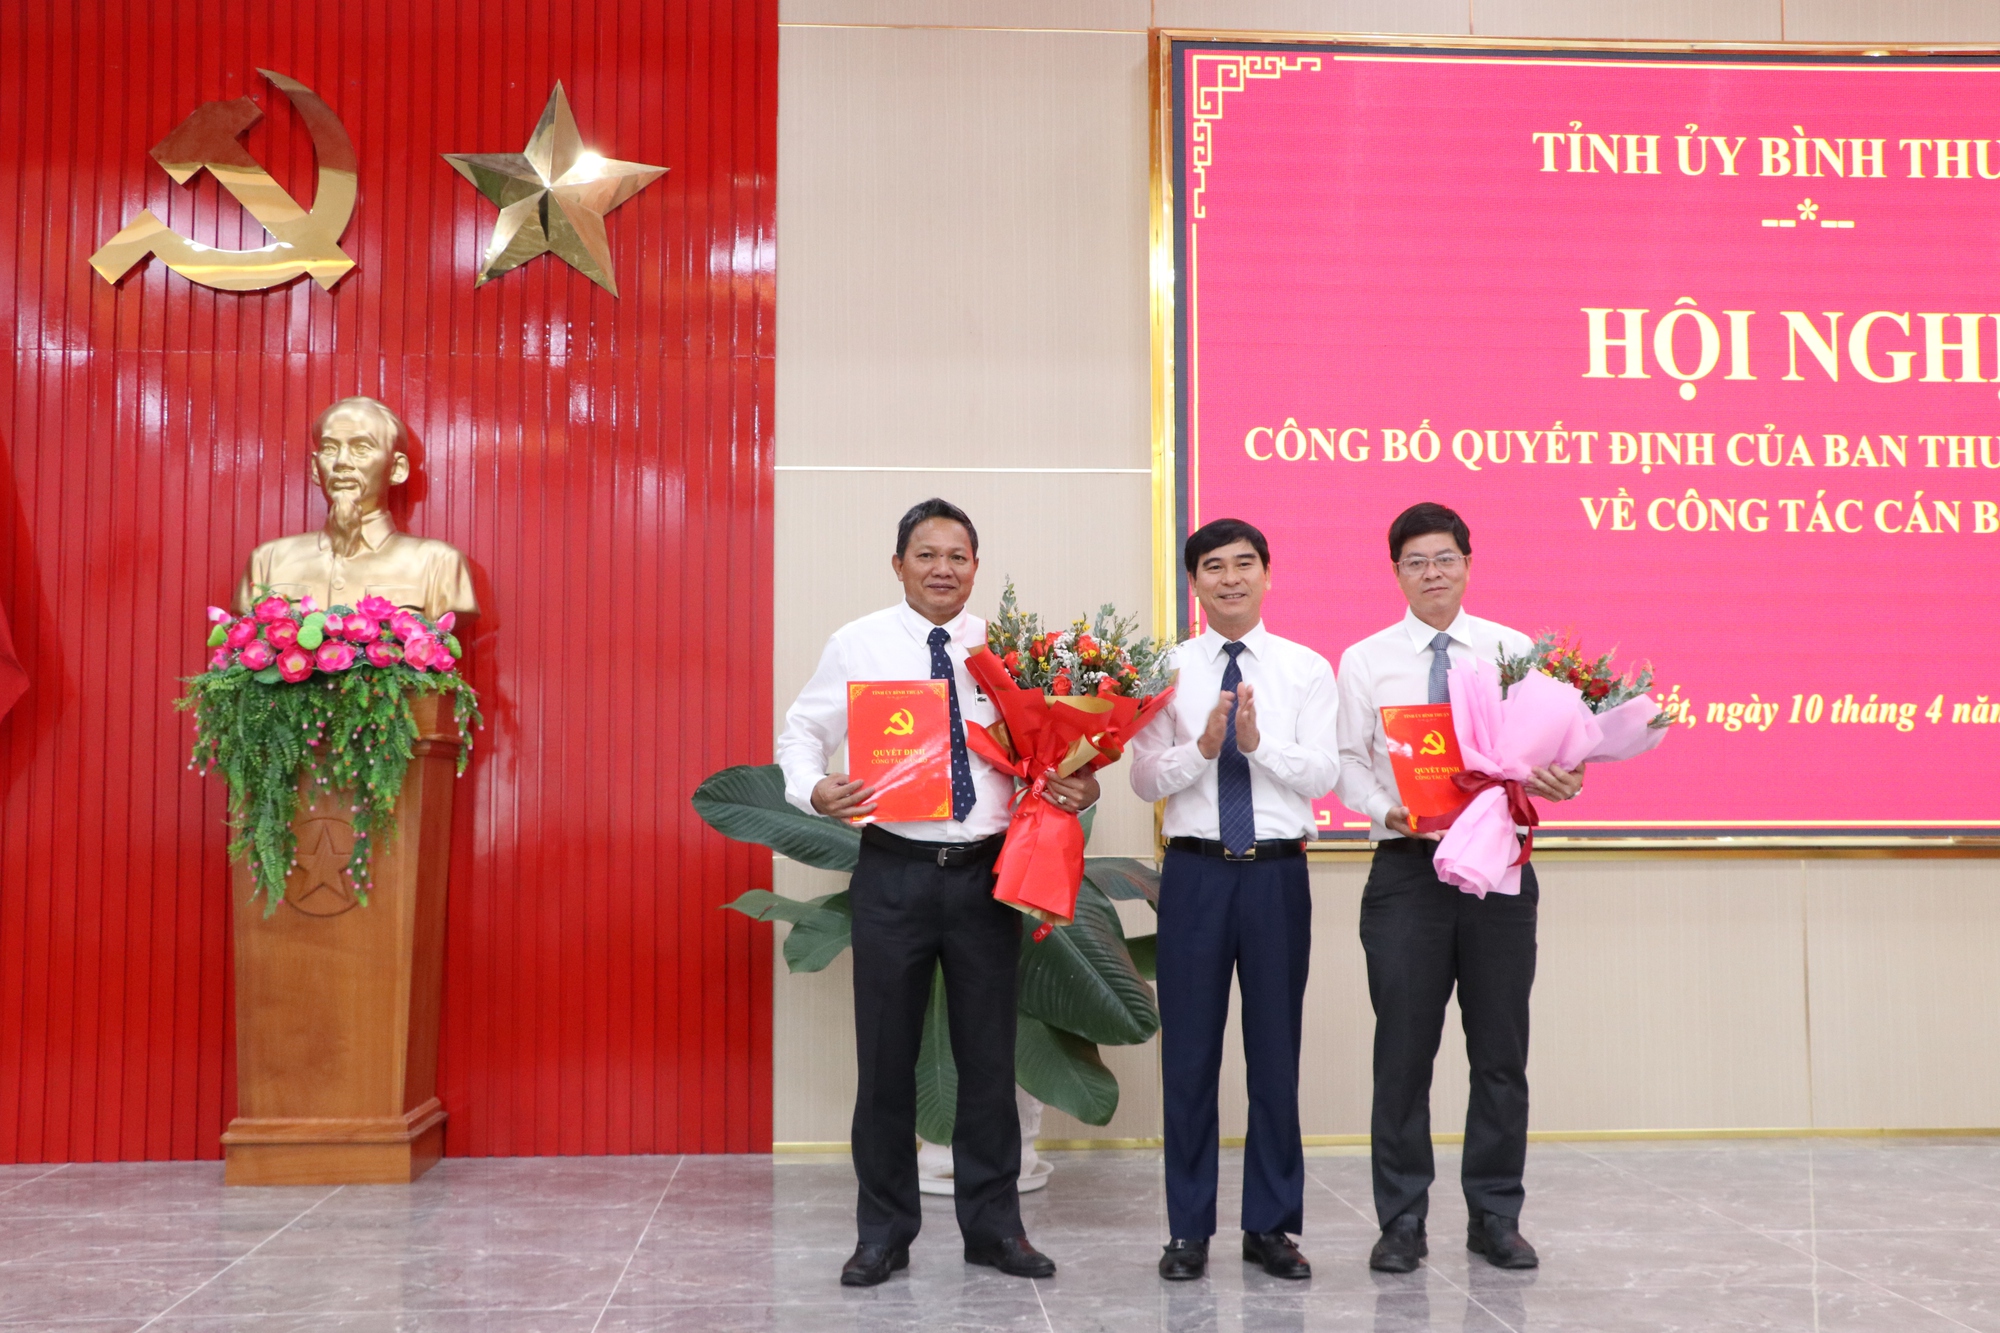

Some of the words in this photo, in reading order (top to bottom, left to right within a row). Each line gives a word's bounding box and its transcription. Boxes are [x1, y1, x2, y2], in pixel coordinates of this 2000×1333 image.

[1532, 120, 1662, 174] TỈNH
[1674, 123, 1747, 176] ỦY
[1757, 125, 1888, 178] BÌNH
[1580, 296, 1758, 401] HỘI
[1244, 416, 1371, 463] CÔNG
[1380, 418, 1441, 463] BỐ
[1451, 420, 1599, 472] QUYẾT
[1608, 431, 1716, 475] ĐỊNH
[1726, 423, 1816, 467] CỦA
[1822, 434, 1909, 468] BAN
[1579, 487, 1637, 531] VỀ
[1646, 487, 1770, 533] CÔNG
[1777, 489, 1864, 534] TÁC
[1873, 489, 1962, 534] CÁN
[1705, 693, 1780, 732] ngày
[1788, 693, 1824, 724] 10
[1830, 693, 1918, 733] tháng
[1924, 693, 1944, 725] 4
[873, 748, 902, 758] QUYẾT
